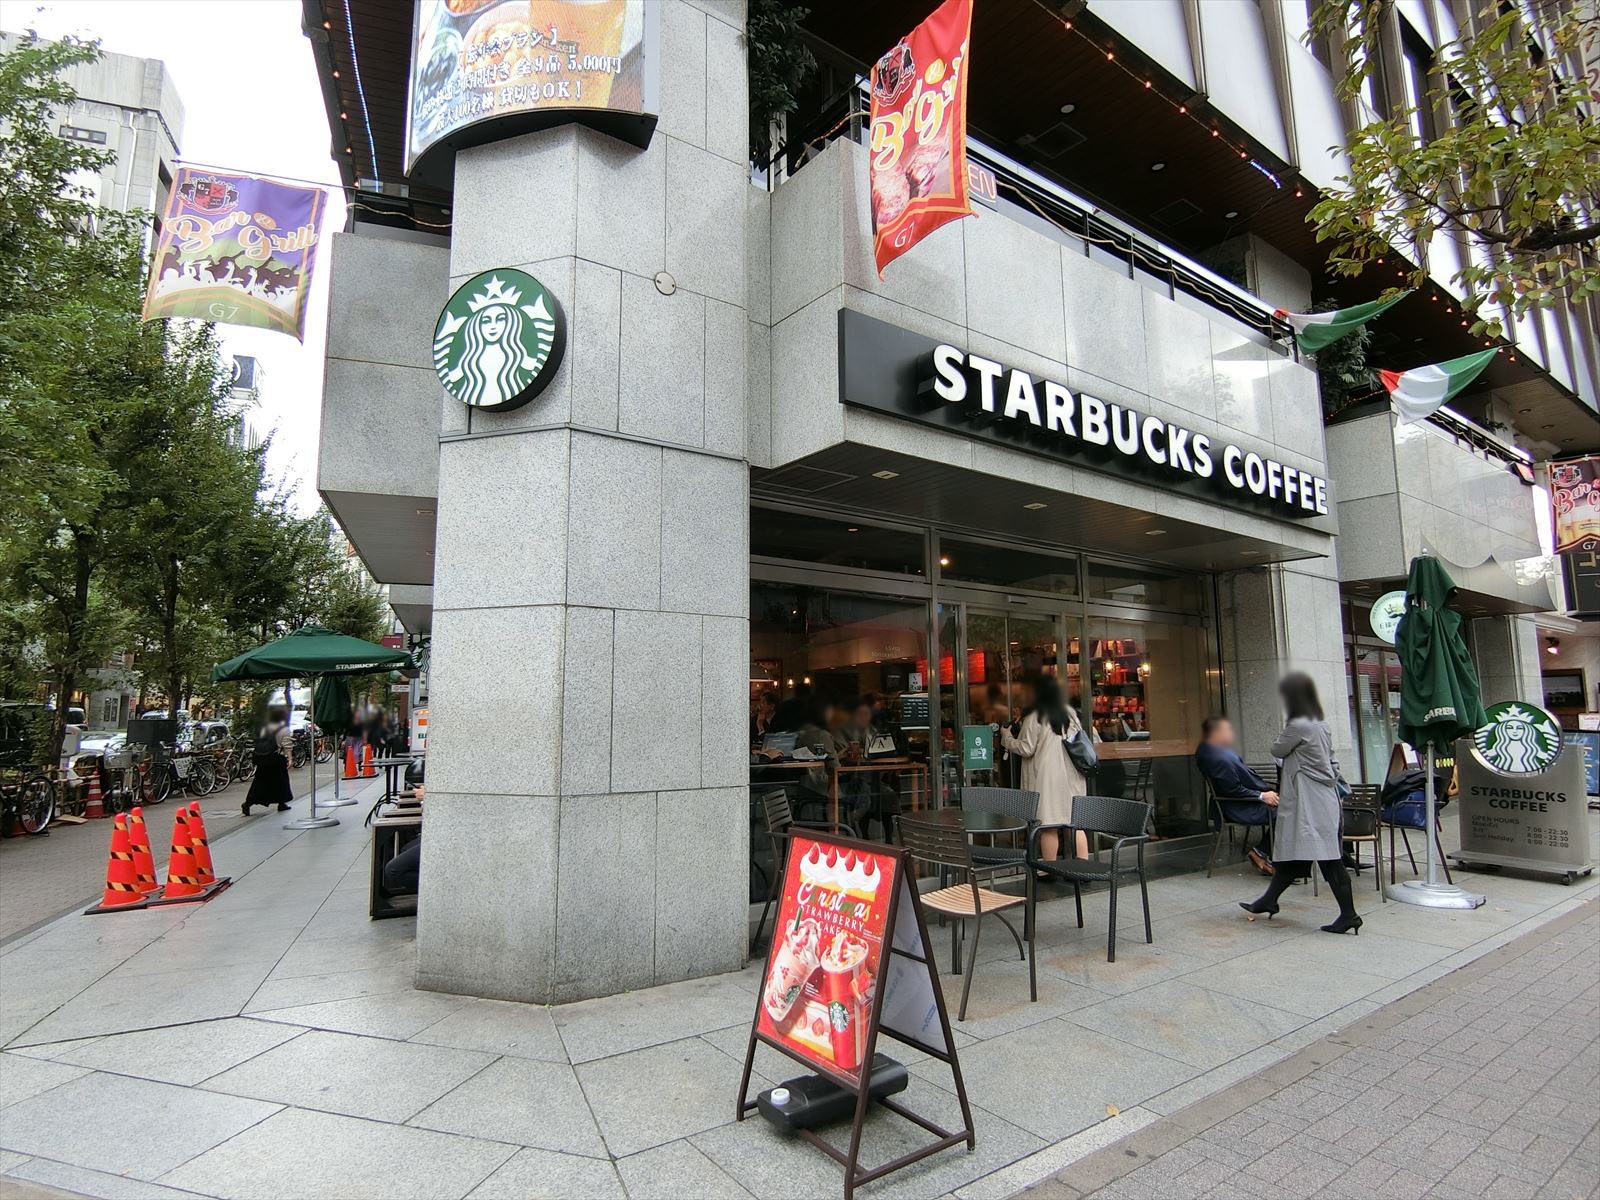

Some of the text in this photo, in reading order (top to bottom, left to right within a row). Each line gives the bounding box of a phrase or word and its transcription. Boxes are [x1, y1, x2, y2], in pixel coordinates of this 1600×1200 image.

[968, 164, 996, 200] EN
[238, 223, 318, 261] Grill
[208, 302, 239, 320] G7
[933, 344, 1328, 515] STARBUCKS COFFEE
[1582, 541, 1597, 550] G7
[1470, 786, 1567, 803] STARBUCKS
[1489, 799, 1548, 812] COFFEE
[1493, 816, 1520, 825] HOURS
[797, 877, 872, 922] Christmas
[801, 904, 865, 932] STRAWBERRY
[819, 920, 841, 935] CAKE
